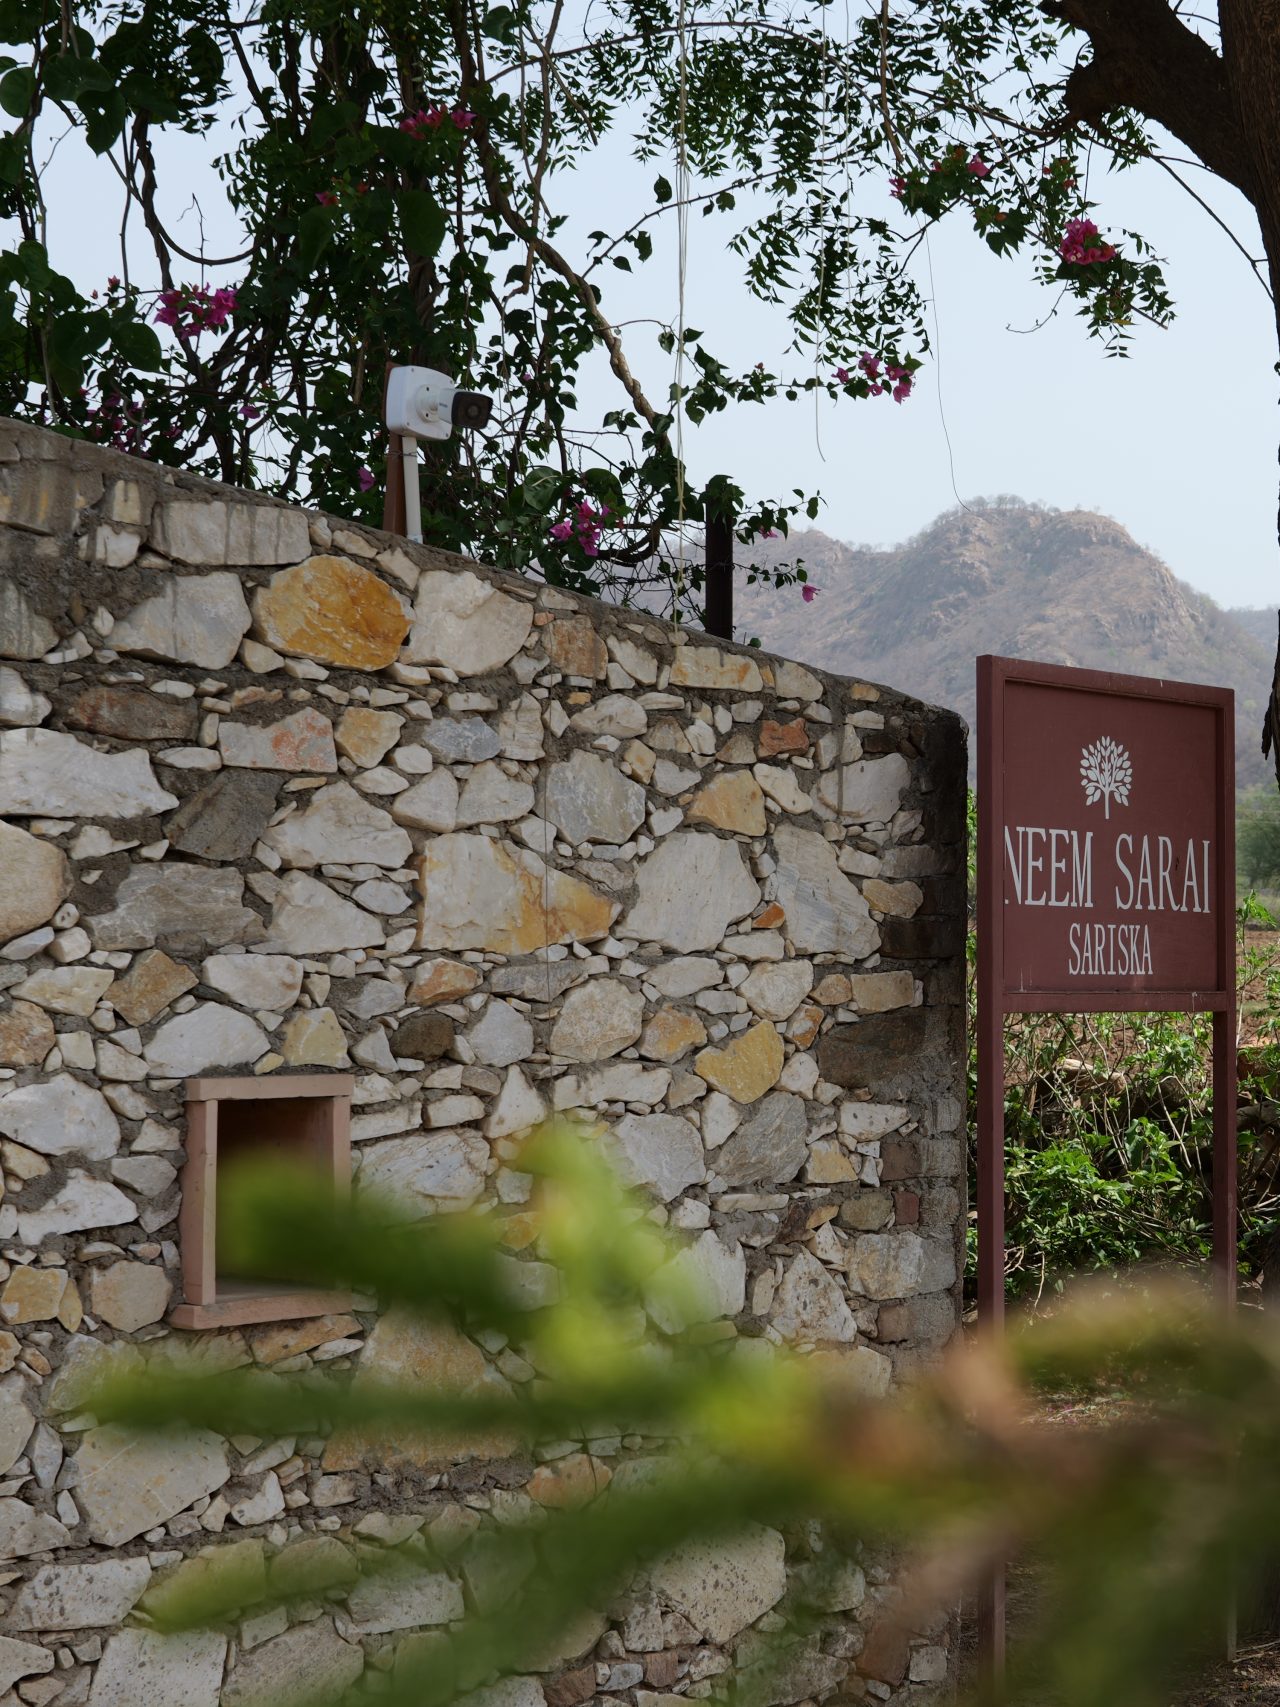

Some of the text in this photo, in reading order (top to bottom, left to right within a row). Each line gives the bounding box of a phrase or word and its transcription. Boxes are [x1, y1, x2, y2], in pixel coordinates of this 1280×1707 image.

[1004, 825, 1211, 914] NEEM SARAI
[1068, 922, 1154, 976] SARISKA
